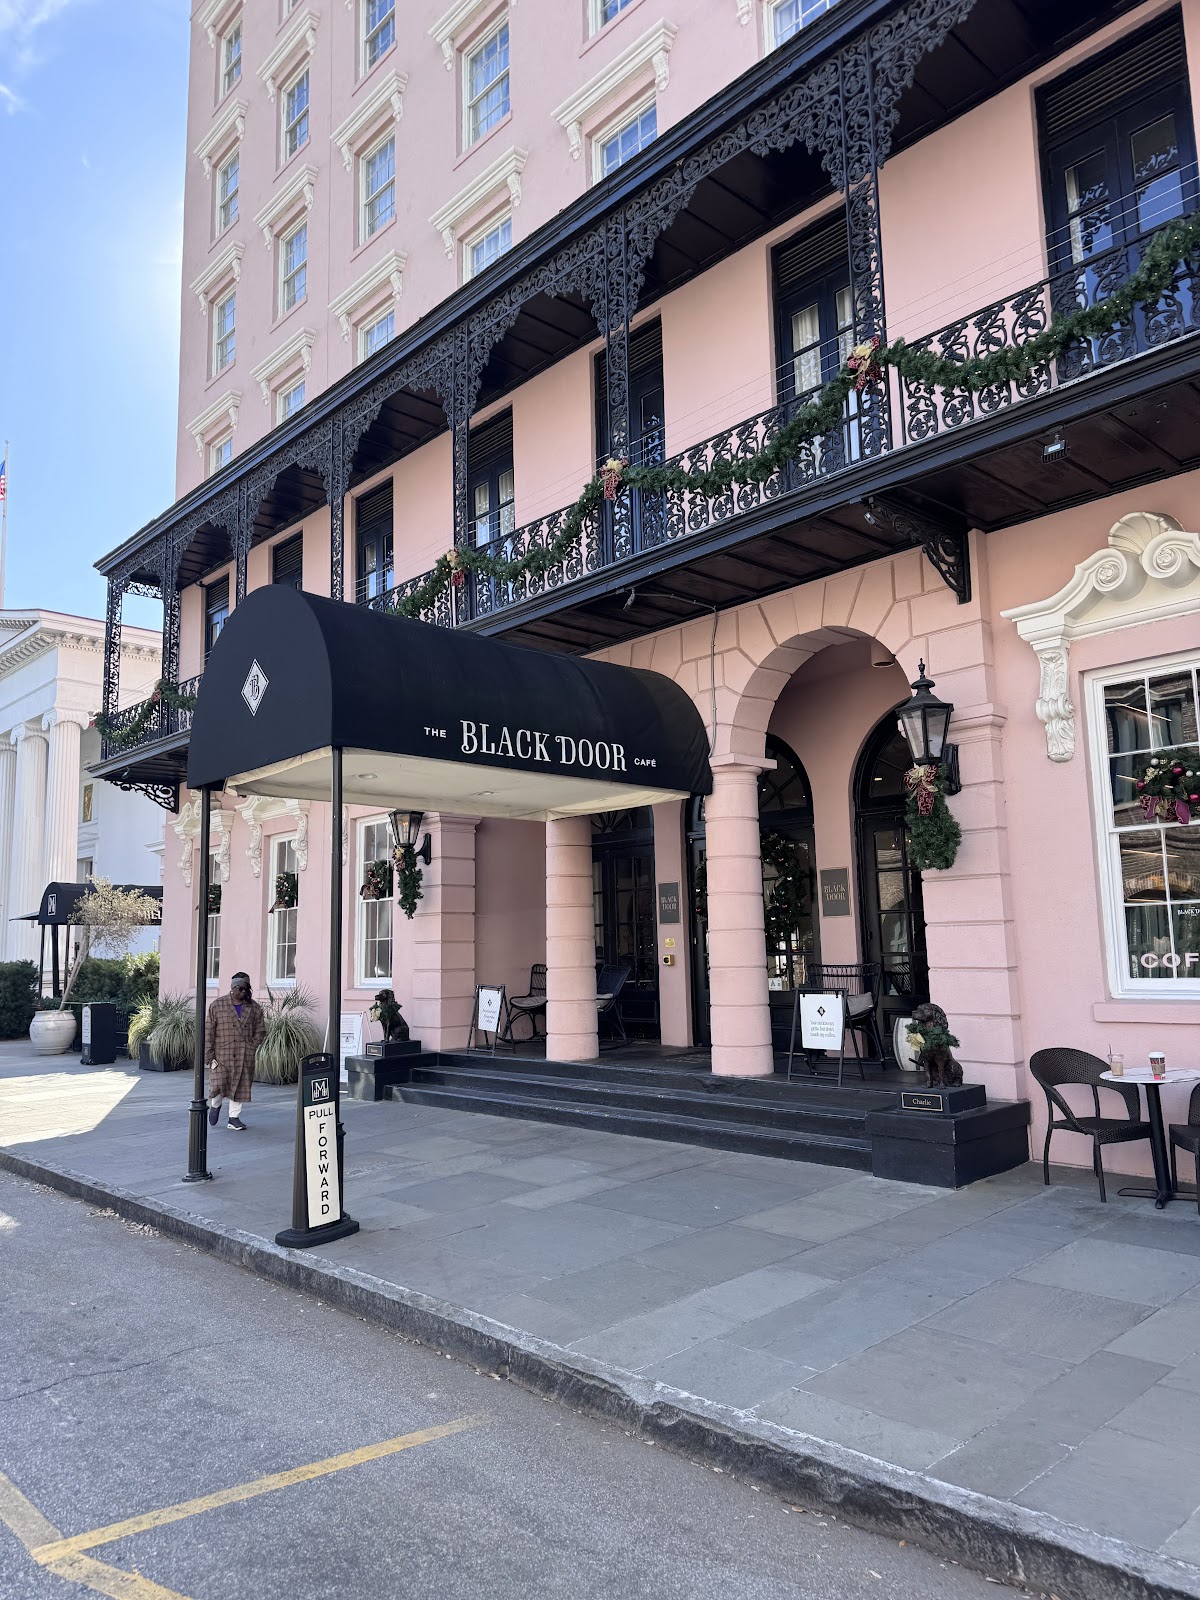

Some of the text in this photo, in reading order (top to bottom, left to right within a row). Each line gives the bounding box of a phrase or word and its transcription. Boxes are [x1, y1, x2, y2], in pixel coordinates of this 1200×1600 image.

[423, 719, 657, 772] THE BLACK DOOR CAFÉ
[823, 884, 846, 893] BLACK
[826, 893, 846, 901] DOOR
[662, 903, 677, 911] DOOR
[1140, 952, 1200, 968] COF
[912, 1098, 932, 1106] Charlie
[308, 1107, 334, 1120] PULL
[317, 1122, 330, 1216] FORWARD
